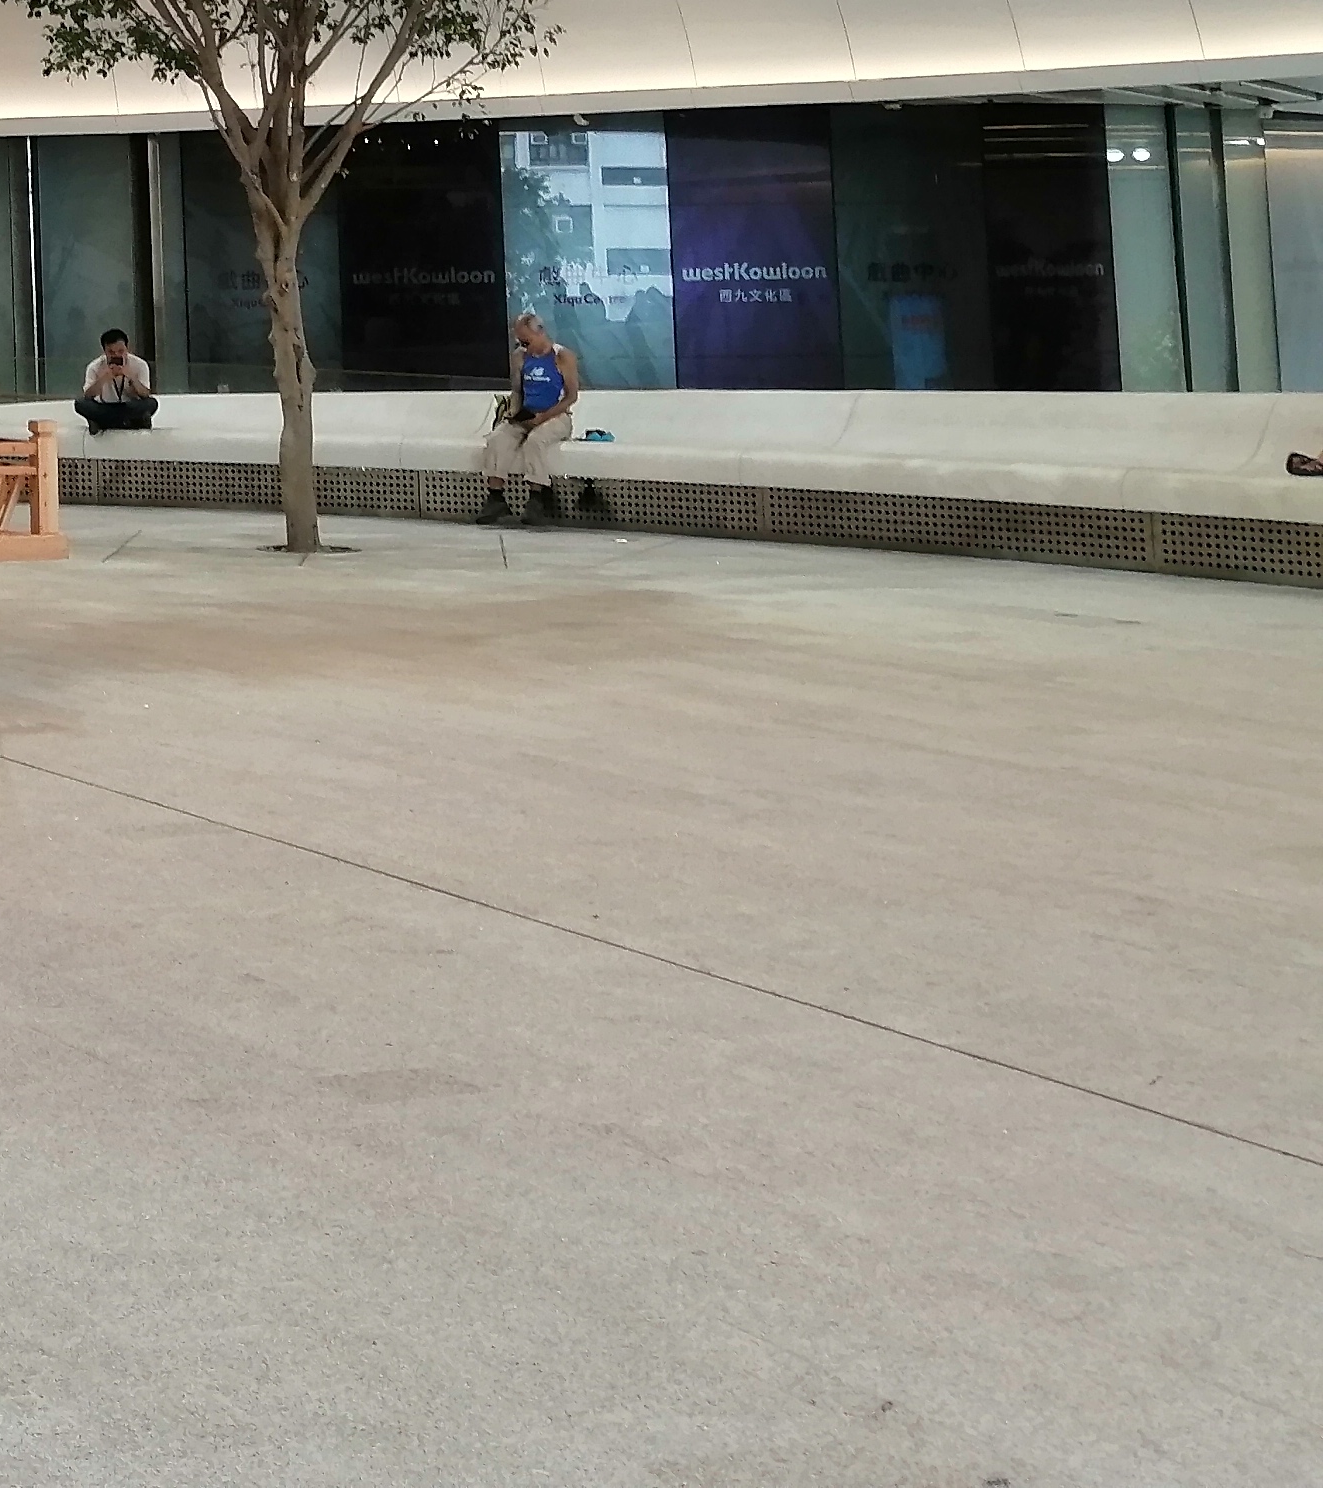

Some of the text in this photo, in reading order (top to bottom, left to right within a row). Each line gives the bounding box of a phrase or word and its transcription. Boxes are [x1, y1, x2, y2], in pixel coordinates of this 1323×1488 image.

[719, 288, 793, 303] 西九文化區
